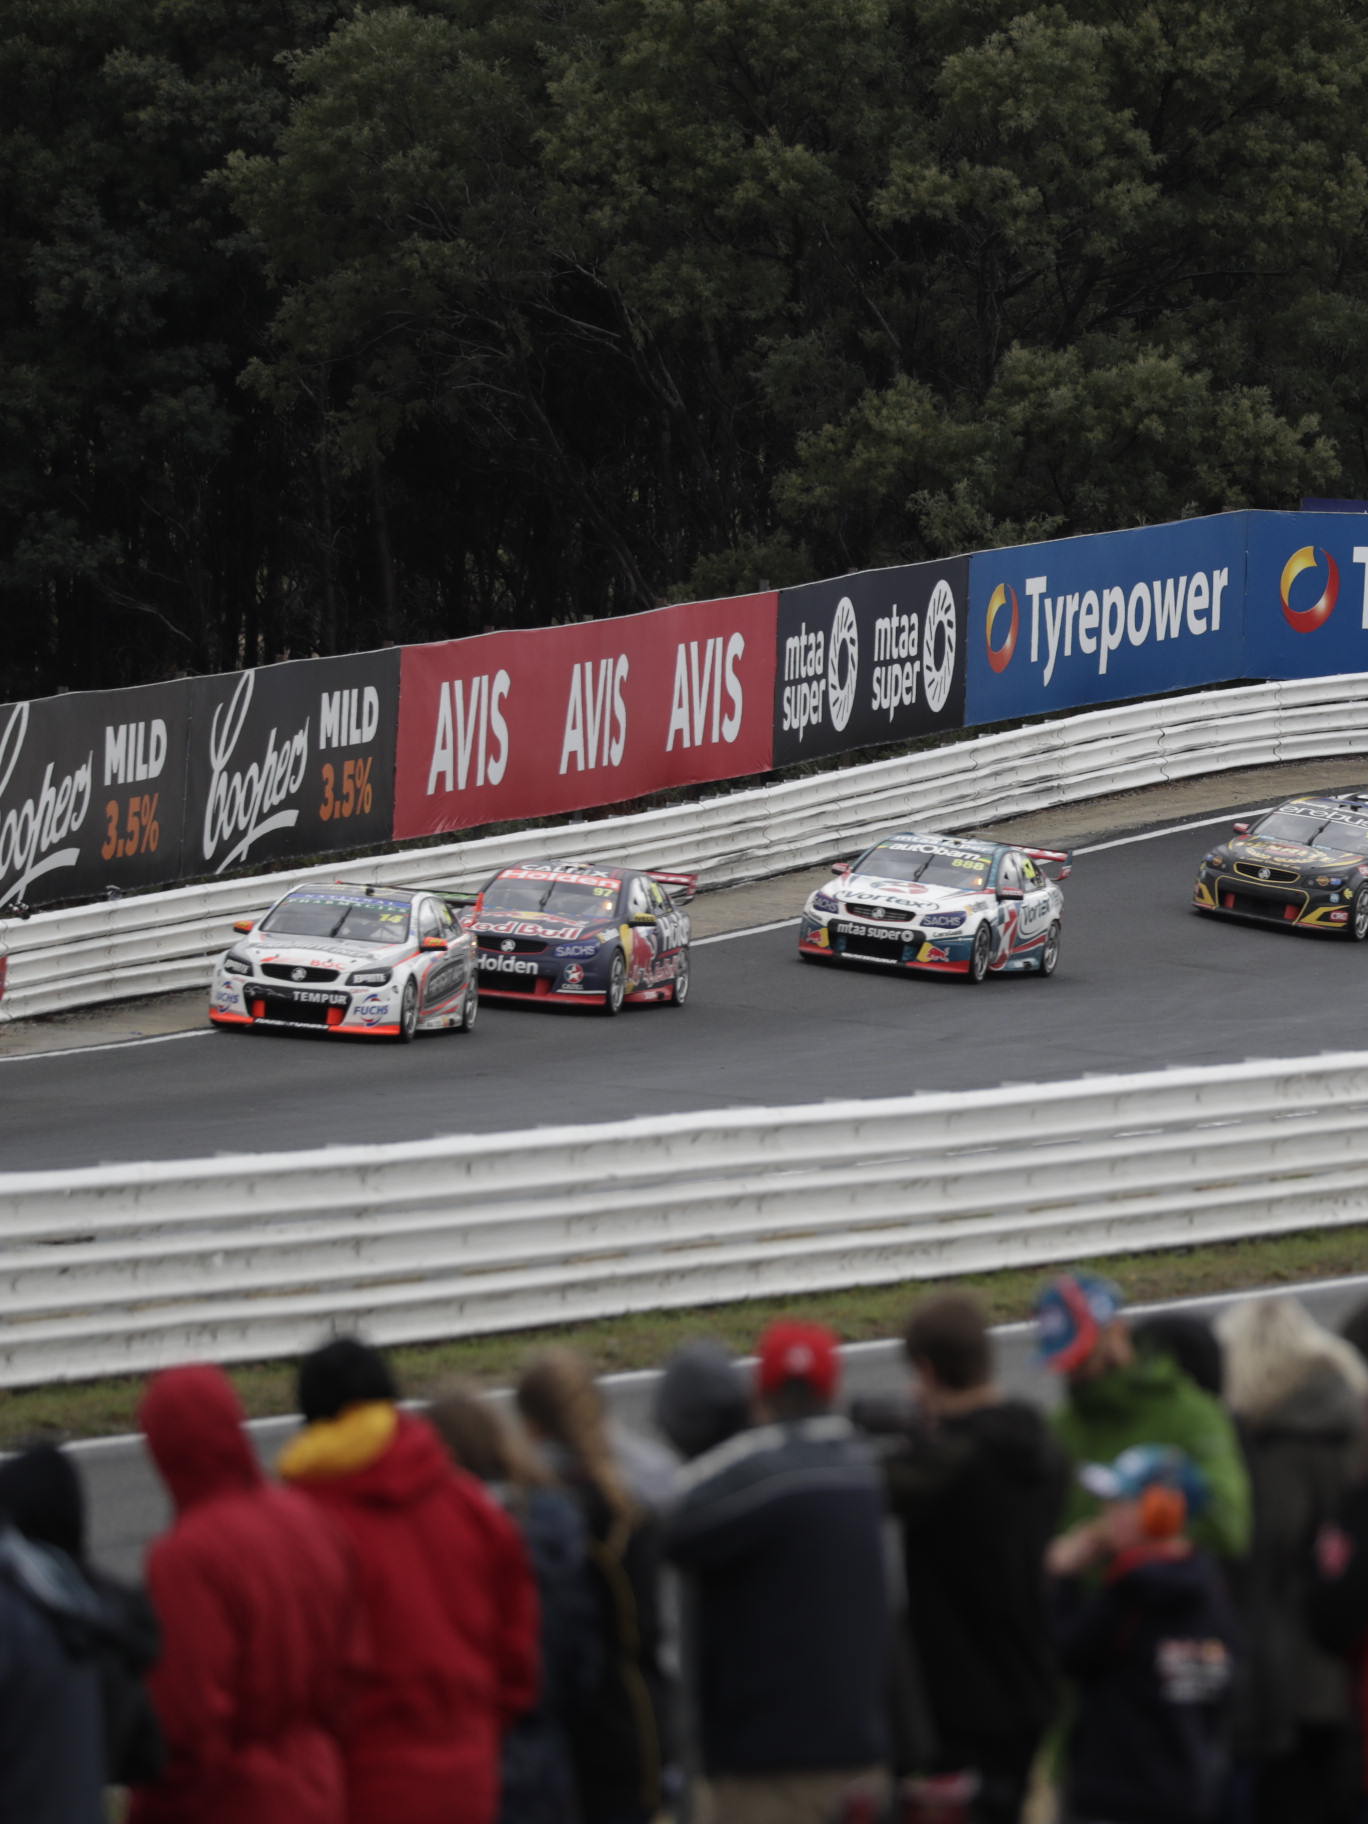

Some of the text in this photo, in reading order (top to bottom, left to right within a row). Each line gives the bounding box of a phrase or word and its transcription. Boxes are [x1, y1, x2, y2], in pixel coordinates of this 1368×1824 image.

[784, 622, 824, 681] mtaa
[874, 604, 918, 669] mtaa
[1025, 566, 1229, 687] Tyrepower
[319, 686, 380, 750] MILD
[559, 654, 629, 775] AVIS
[666, 632, 745, 752] AVIS
[783, 679, 826, 743] super
[871, 664, 921, 723] super
[104, 719, 167, 786] MILD
[427, 669, 511, 795] AVIS
[203, 669, 310, 874] Coopers
[319, 757, 374, 822] 3.5%
[102, 793, 160, 860] 3.5%
[499, 869, 620, 889] Holden
[593, 887, 614, 897] 97
[952, 858, 985, 870] 888
[514, 922, 583, 940] Bull
[837, 923, 901, 941] mtaa super
[924, 915, 961, 926] SACHS
[555, 946, 596, 957] SACHS
[292, 990, 348, 1005] TEMPUR
[353, 1004, 389, 1016] FUCHS
